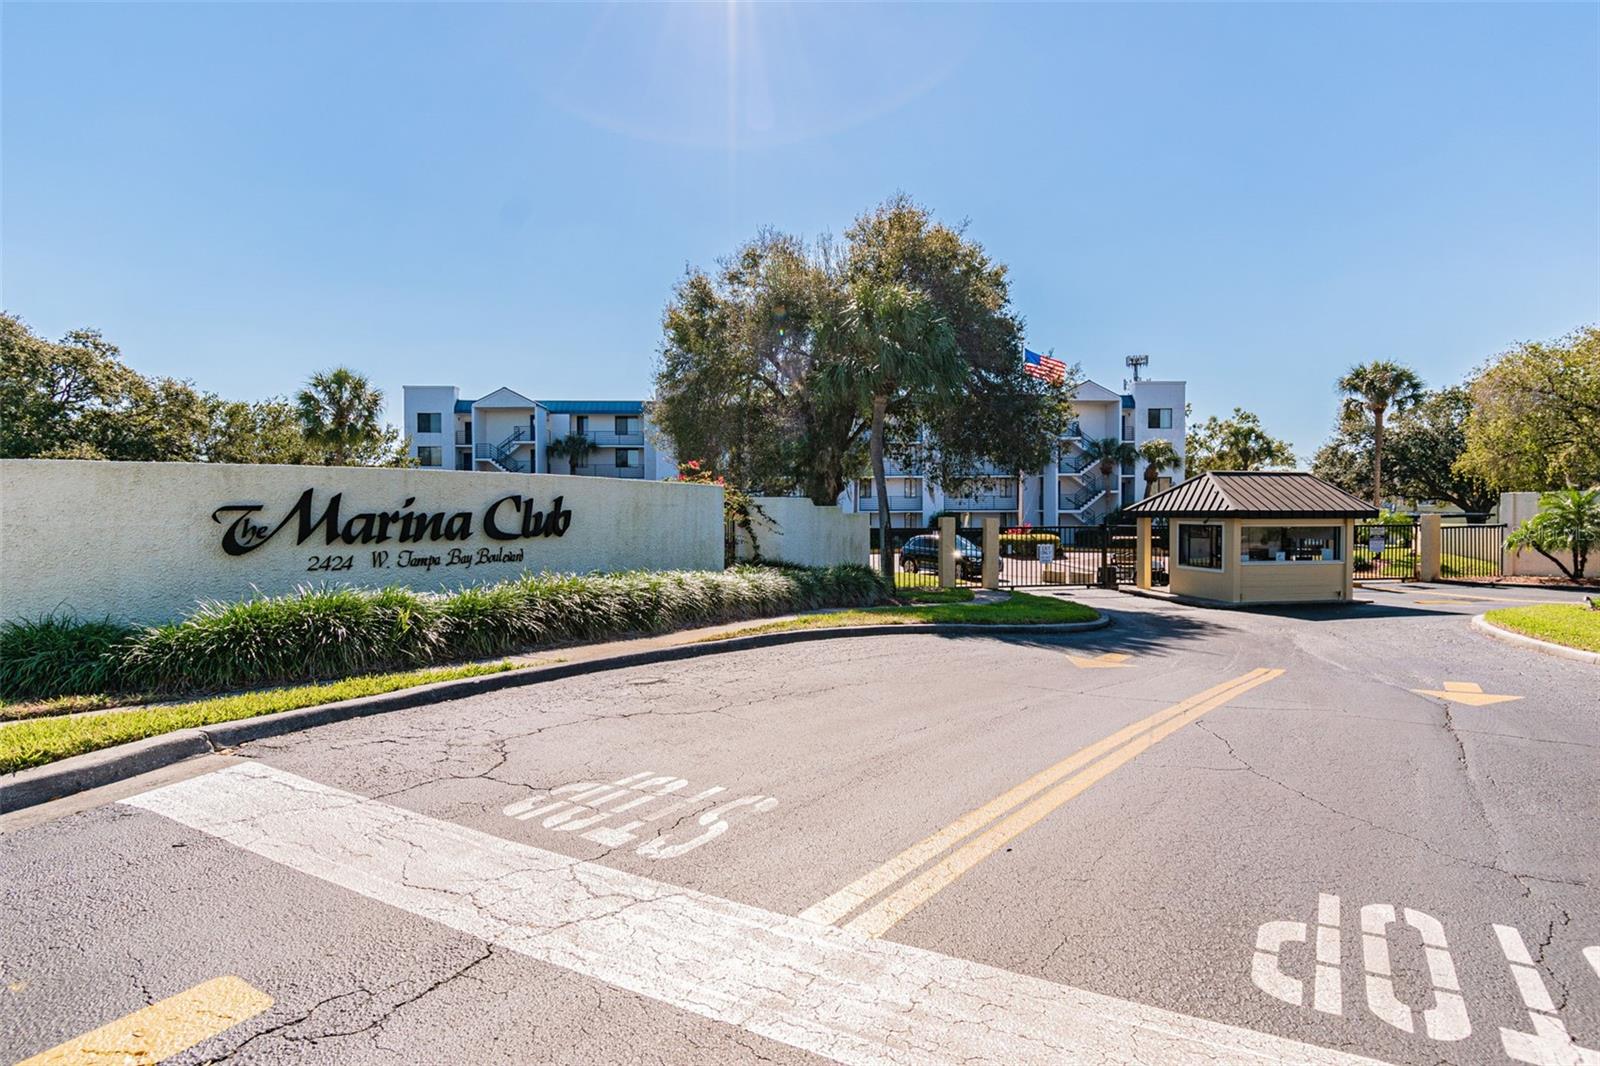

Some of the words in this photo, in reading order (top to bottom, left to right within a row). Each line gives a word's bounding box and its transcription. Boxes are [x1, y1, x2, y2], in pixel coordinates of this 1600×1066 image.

[211, 504, 270, 556] The
[271, 487, 474, 546] Marina
[483, 495, 572, 542] Club
[307, 555, 354, 571] 2424
[372, 550, 390, 569] W.
[397, 550, 440, 571] Tampa
[445, 548, 473, 569] Bay
[475, 547, 524, 566] Boulevard
[502, 771, 779, 859] STOP
[1251, 892, 1600, 1066] TOP
